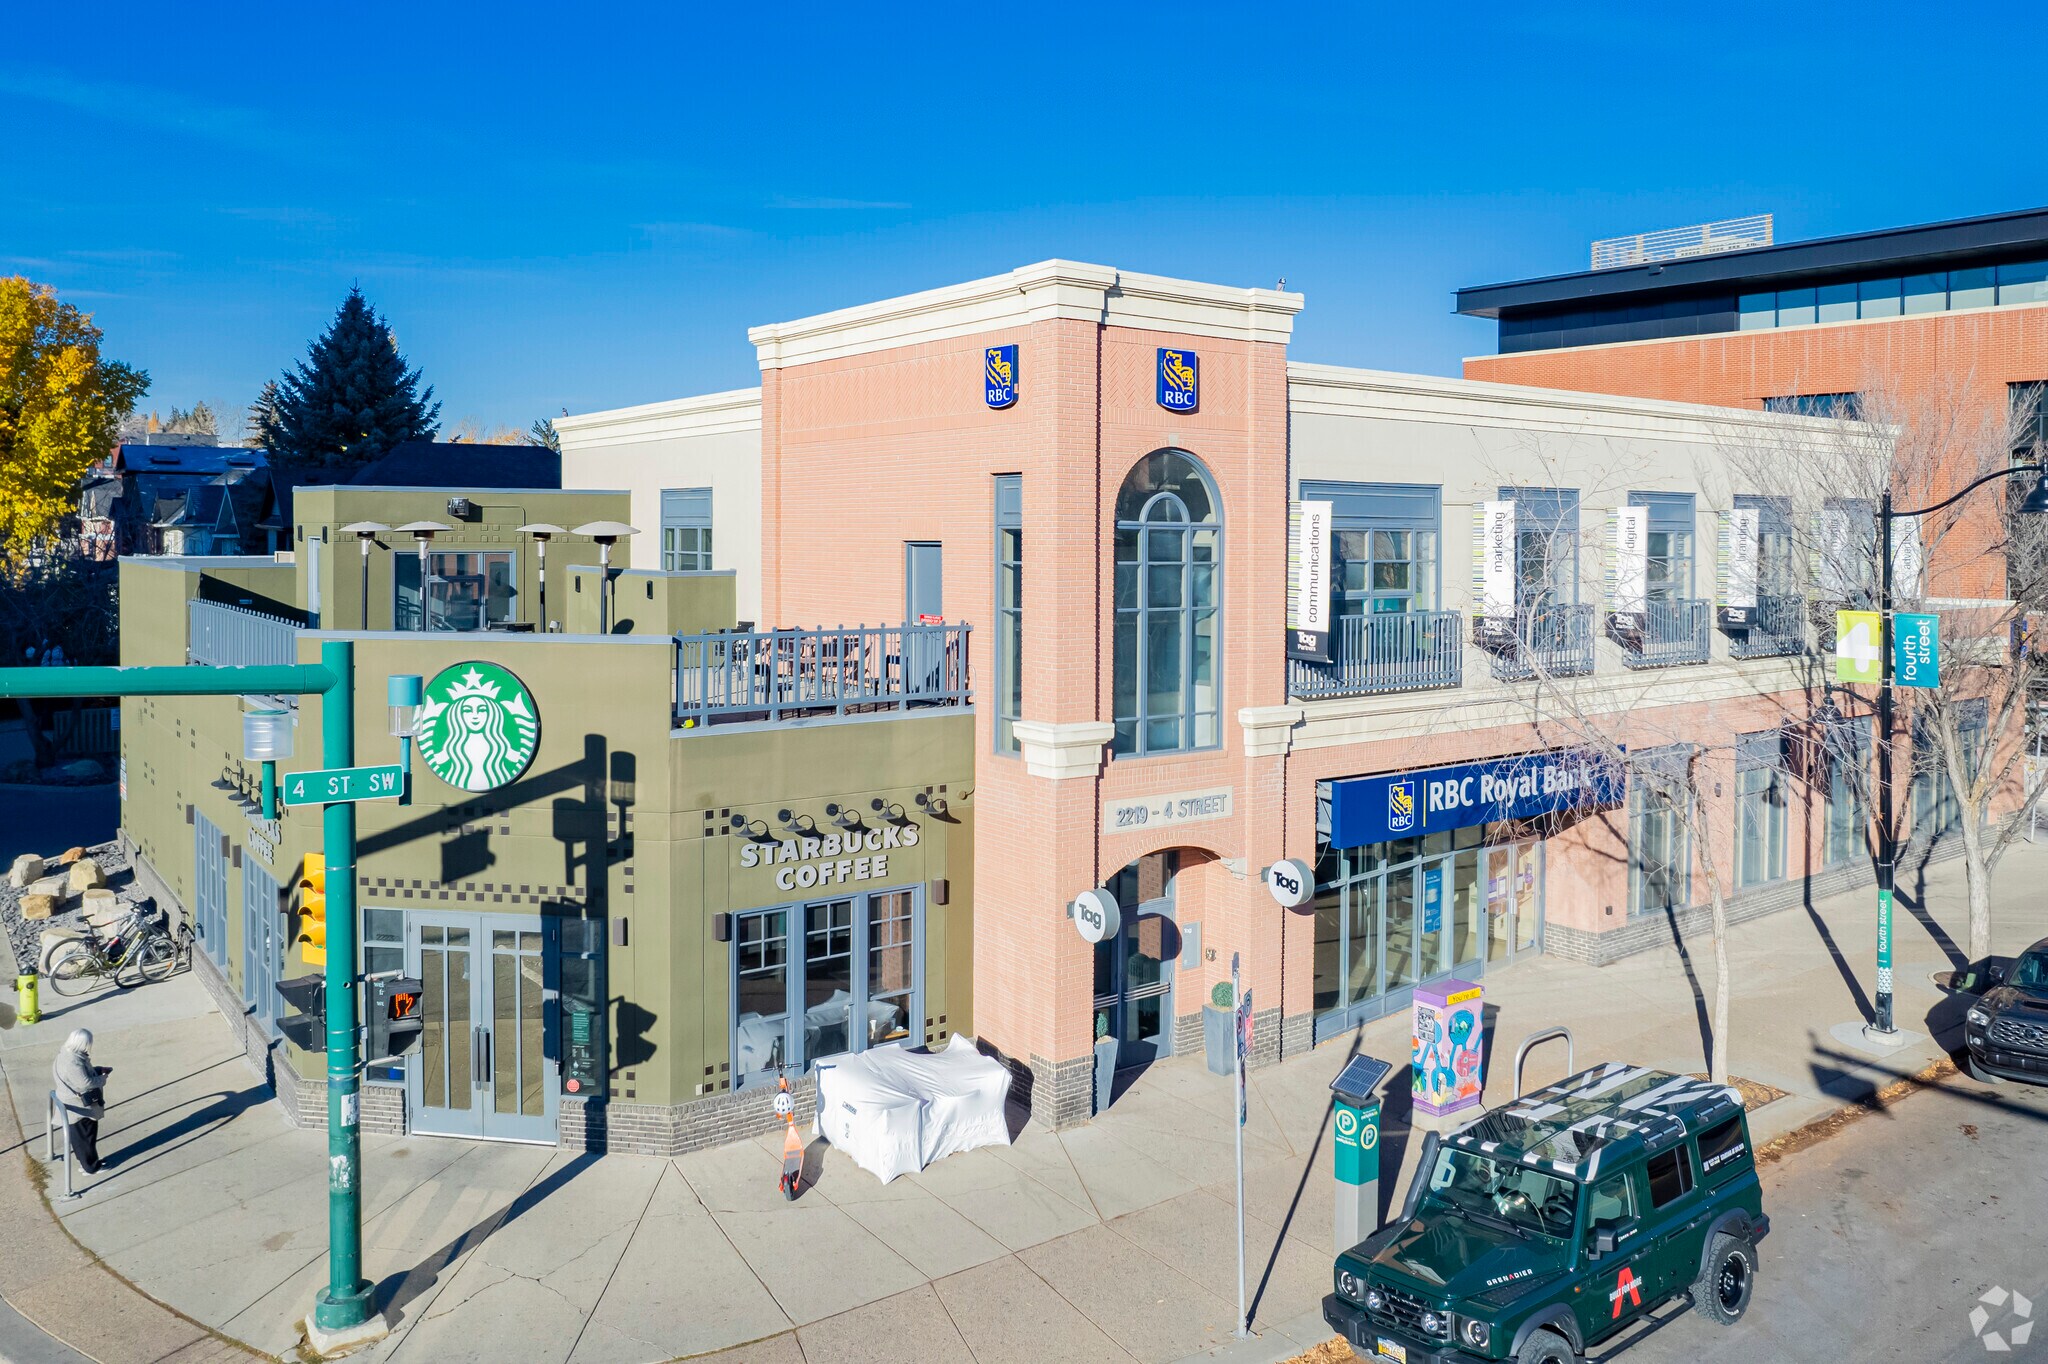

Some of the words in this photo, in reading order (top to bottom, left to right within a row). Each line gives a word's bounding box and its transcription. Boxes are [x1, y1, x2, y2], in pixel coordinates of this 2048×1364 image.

[988, 388, 1010, 402] RBC
[1165, 391, 1193, 405] RBC
[1493, 512, 1506, 573] marketing
[1625, 516, 1637, 549] digital
[1737, 518, 1749, 562] branding
[1309, 513, 1320, 623] communications
[1297, 631, 1317, 647] Tag
[1917, 620, 1930, 664] street
[1903, 635, 1917, 681] fourth
[293, 779, 305, 798] 4
[327, 776, 351, 796] ST
[369, 772, 395, 792] SW
[1429, 777, 1474, 812] RBC
[1481, 766, 1539, 808] Royal
[1544, 758, 1592, 794] Bank
[1116, 806, 1149, 827] 2219
[1164, 801, 1173, 819] 4
[1178, 794, 1227, 818] STREET
[1391, 815, 1412, 828] RBC
[740, 825, 921, 868] STARBUCKS
[775, 855, 889, 891] COFFEE
[1274, 871, 1299, 895] Tag
[1079, 903, 1102, 930] Tag
[1879, 899, 1887, 925] street
[1878, 926, 1887, 953] fourth
